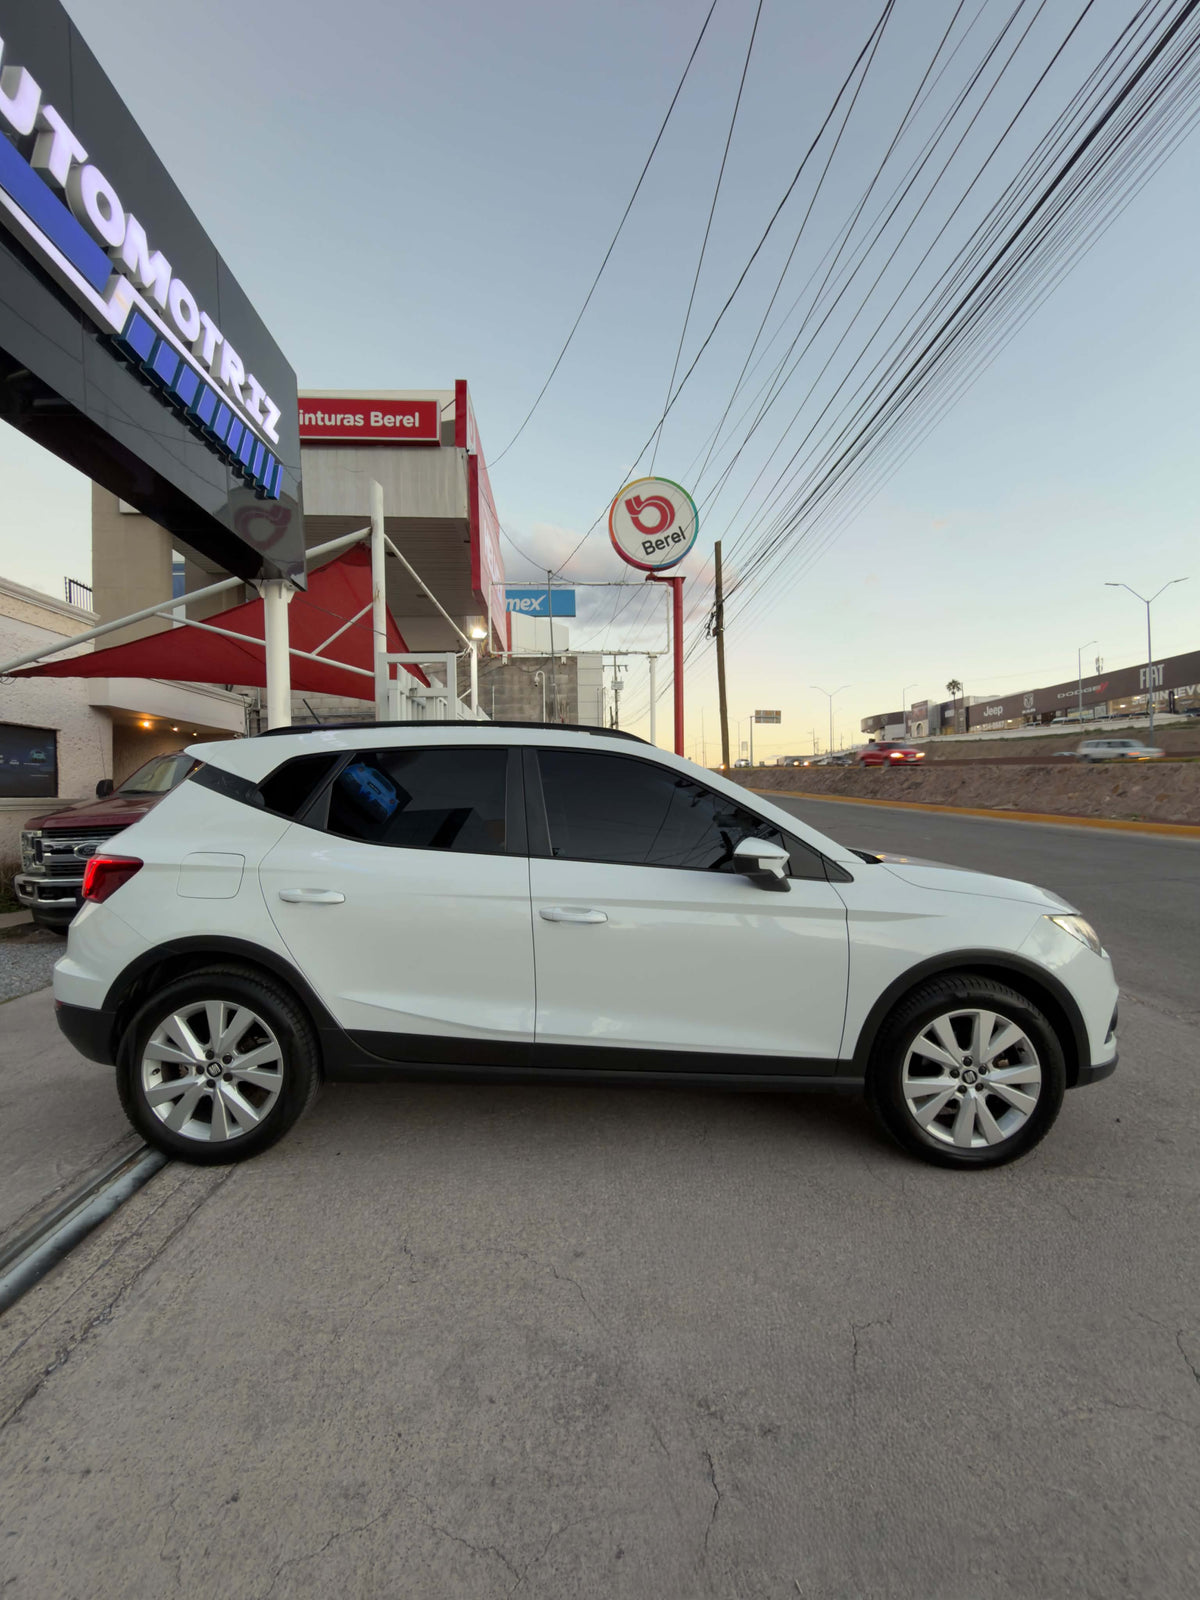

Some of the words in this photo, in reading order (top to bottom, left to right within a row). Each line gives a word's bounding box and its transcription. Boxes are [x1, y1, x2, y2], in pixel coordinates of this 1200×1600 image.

[299, 410, 364, 426] inturas
[370, 411, 419, 428] Berel
[641, 526, 687, 556] Berel
[505, 594, 547, 611] mex
[1139, 663, 1165, 689] FIAT
[983, 705, 1004, 717] Jeep
